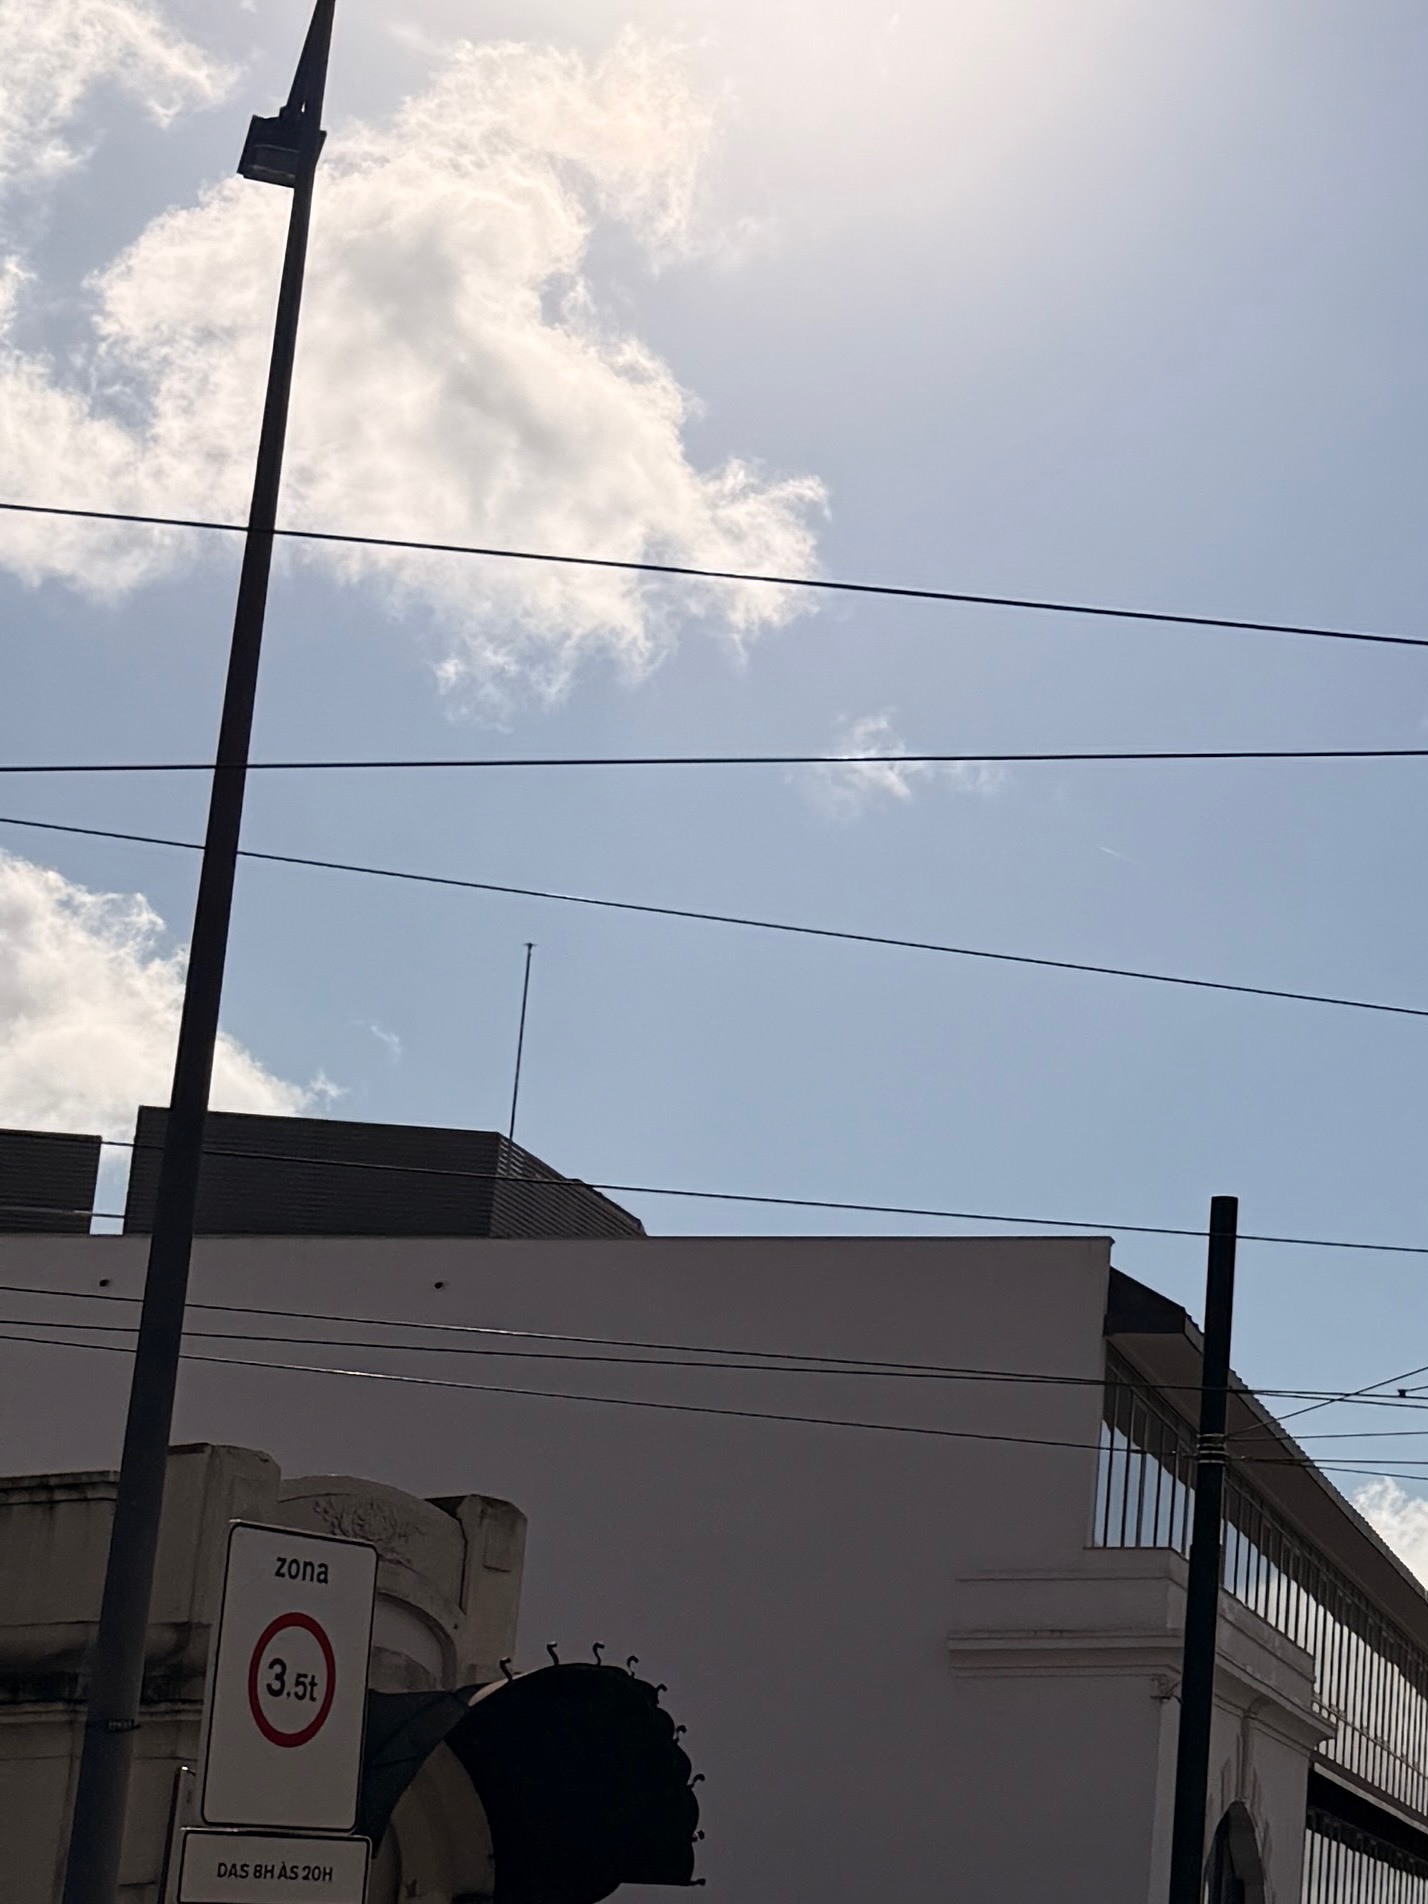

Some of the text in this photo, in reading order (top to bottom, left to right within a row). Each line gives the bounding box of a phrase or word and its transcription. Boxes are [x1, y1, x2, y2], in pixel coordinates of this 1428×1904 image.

[274, 1556, 329, 1584] zona
[217, 1860, 333, 1882] DAS 8H ÀS 20H
